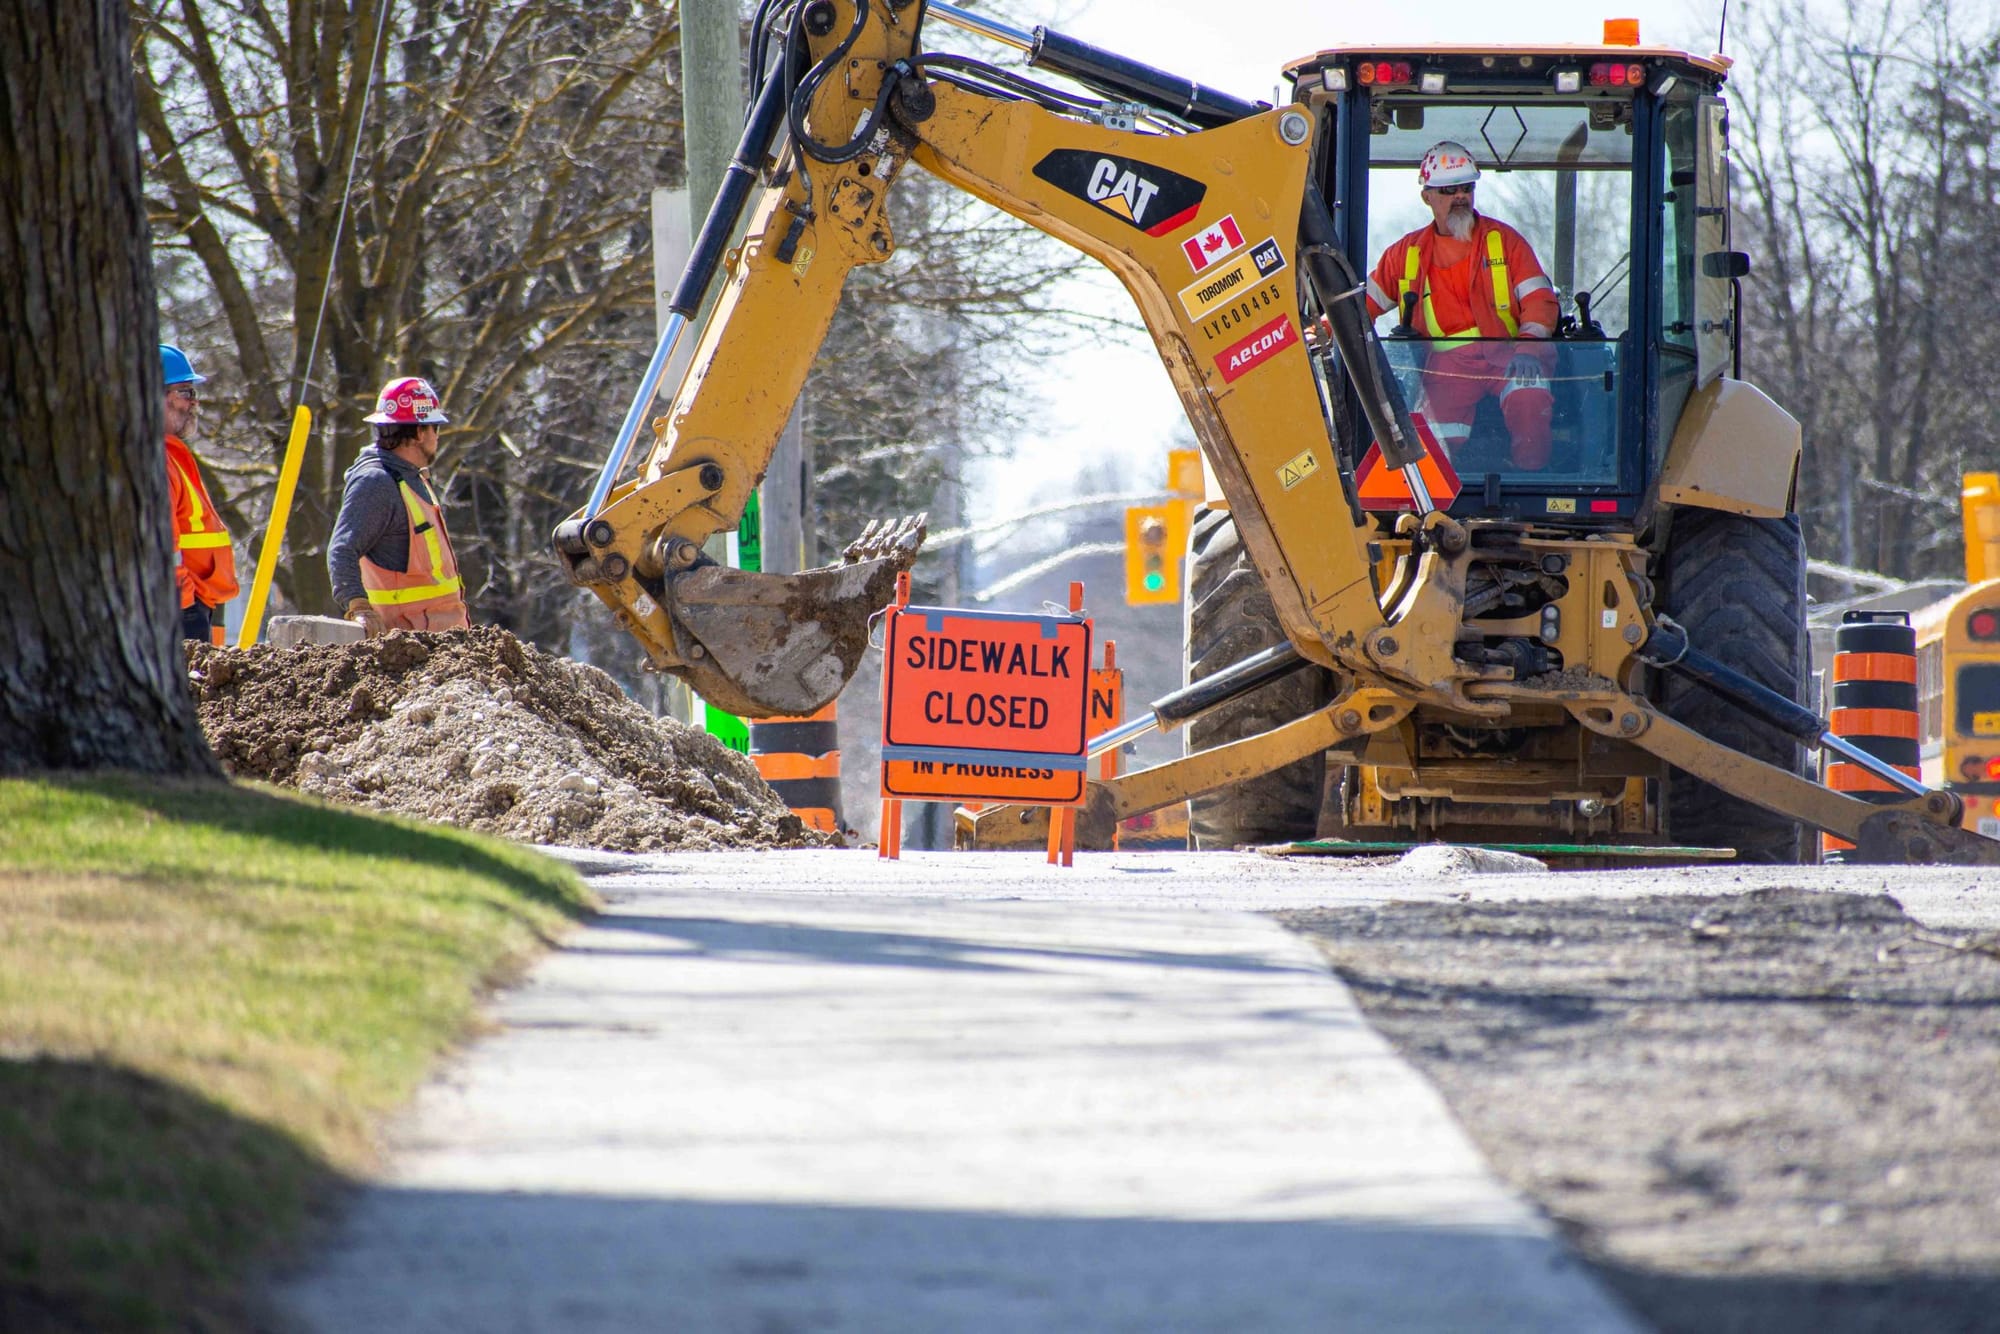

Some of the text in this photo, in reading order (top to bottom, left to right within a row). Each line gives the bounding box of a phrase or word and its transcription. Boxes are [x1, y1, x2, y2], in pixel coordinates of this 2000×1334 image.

[1087, 158, 1159, 224] CAT
[1196, 246, 1279, 304] TOROMONT CAT
[1203, 284, 1280, 340] LYC00485
[907, 636, 1070, 678] SIDEWALK
[925, 691, 1049, 730] CLOSED
[912, 760, 1054, 780] IN PROGRESS
